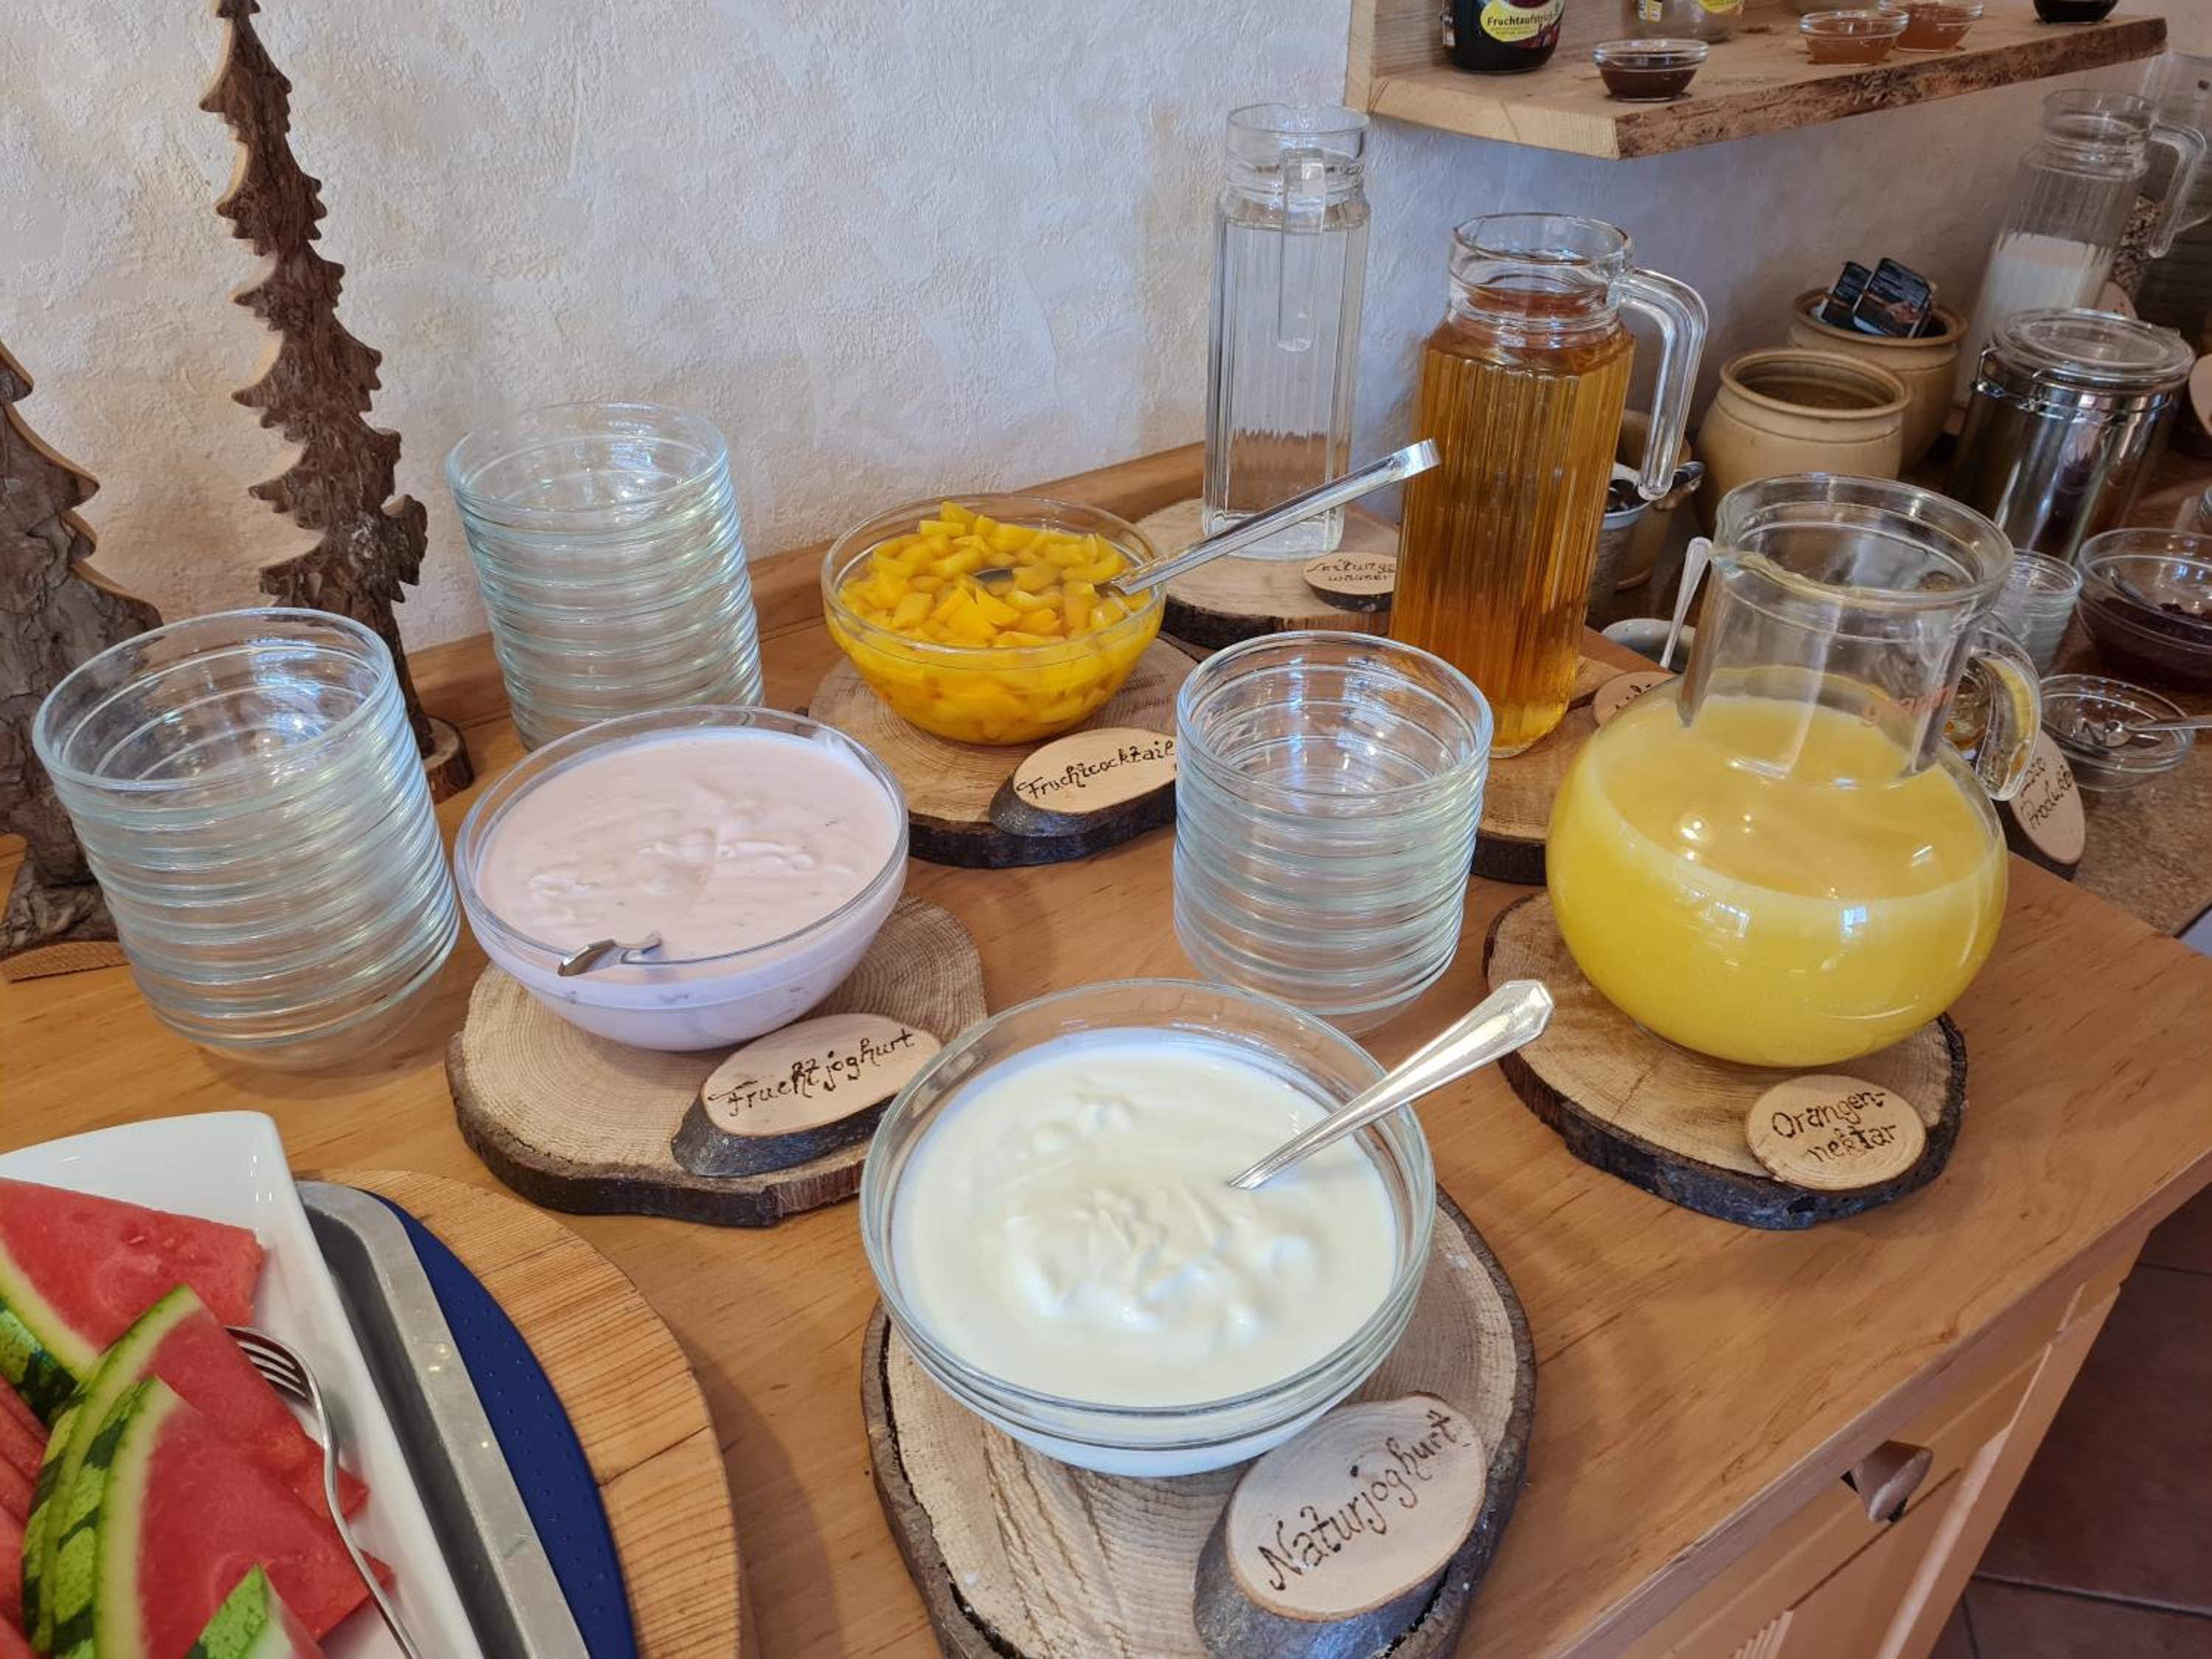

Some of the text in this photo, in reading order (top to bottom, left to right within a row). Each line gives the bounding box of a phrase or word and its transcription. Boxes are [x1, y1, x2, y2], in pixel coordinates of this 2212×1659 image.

[1015, 740, 1175, 799] Fruchtcocktail
[708, 1028, 915, 1117] Fruchtjoghurt
[1806, 1124, 1897, 1163] nektar
[1257, 1409, 1458, 1592] Naturjoghurt
